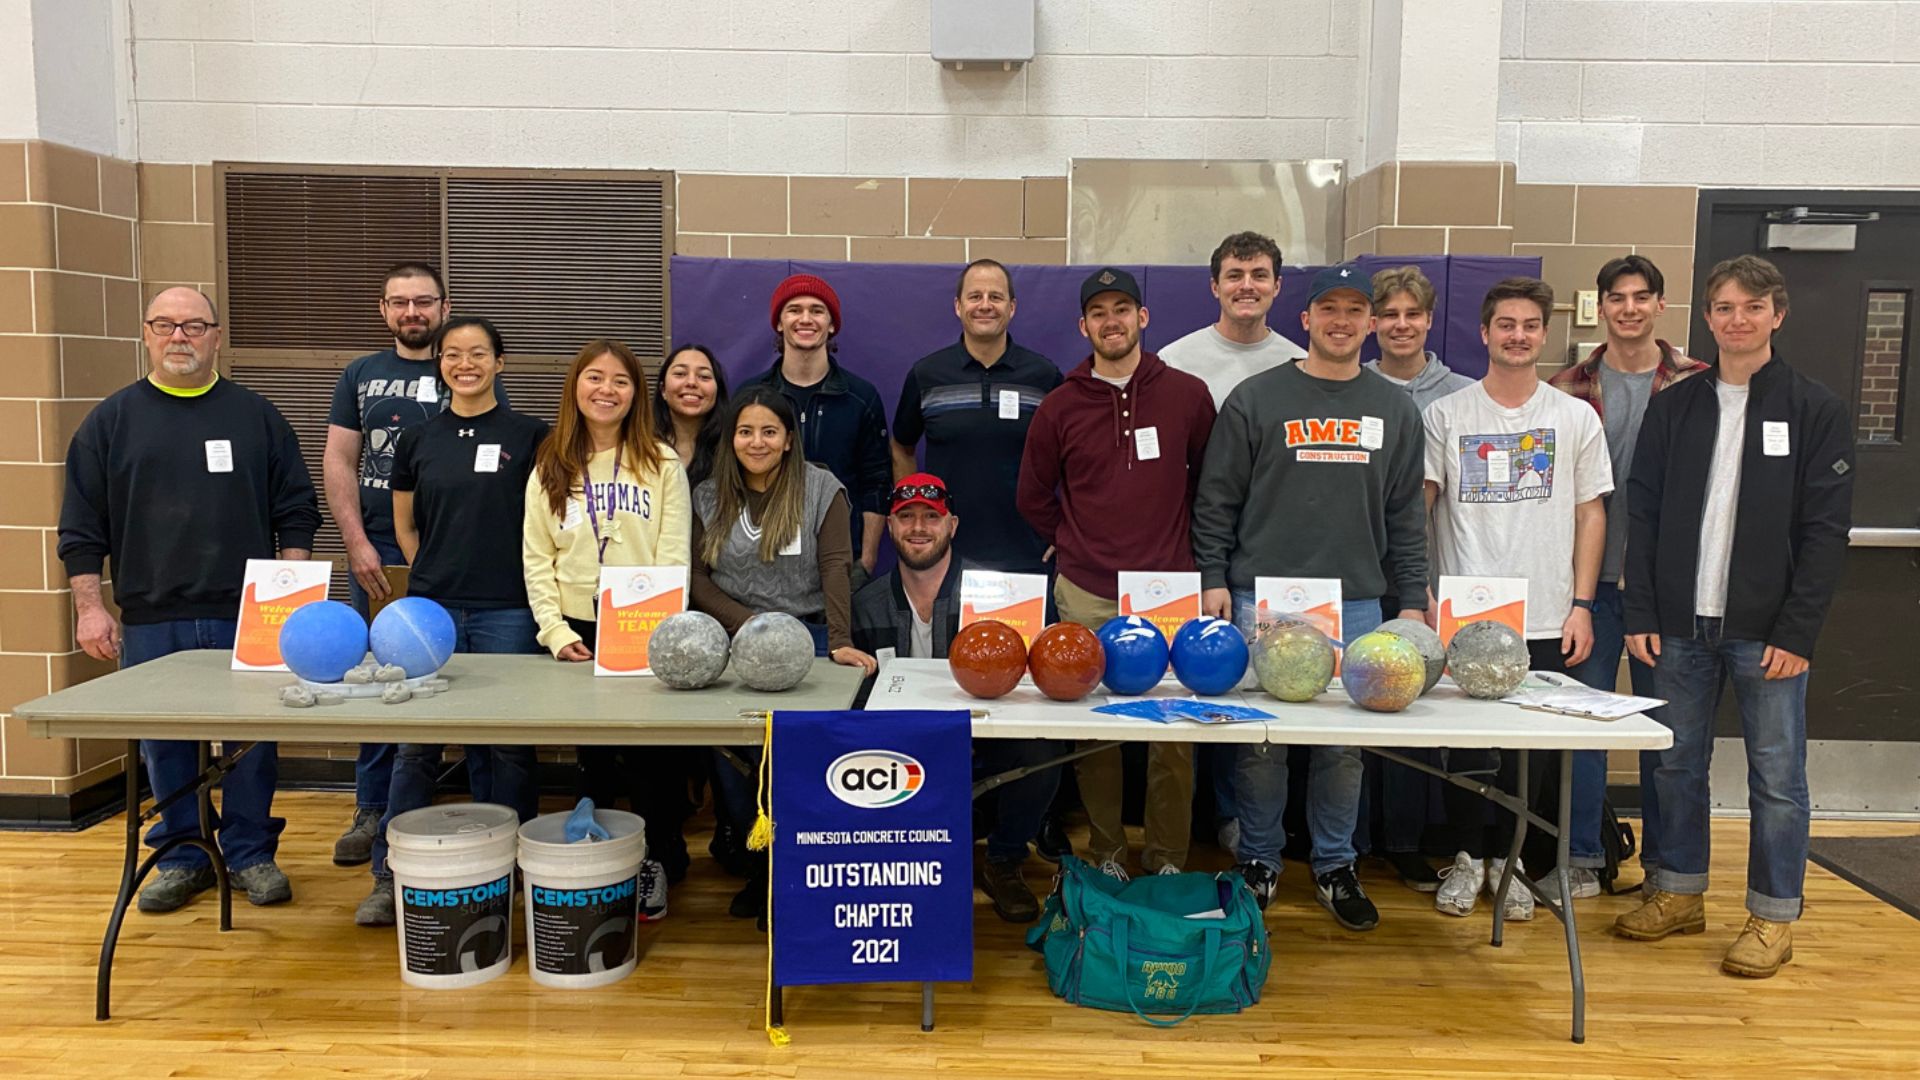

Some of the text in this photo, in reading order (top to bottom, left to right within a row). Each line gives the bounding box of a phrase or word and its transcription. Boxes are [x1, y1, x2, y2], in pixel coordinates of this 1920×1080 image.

[1285, 418, 1362, 447] AME
[1299, 451, 1367, 462] CONSTRUCTION
[586, 482, 651, 520] HOMAS
[259, 604, 295, 614] Welco
[261, 614, 287, 625] TEA
[617, 610, 669, 619] Welcome
[841, 762, 898, 791] aci
[796, 829, 952, 845] MINNESOTA CONCRETE COUNCIL
[805, 861, 942, 888] OUTSTANDING
[403, 876, 509, 908] CEMSTONE
[533, 878, 636, 908] CEMSTONE
[834, 903, 913, 928] CHAPTER
[852, 938, 899, 964] 2021
